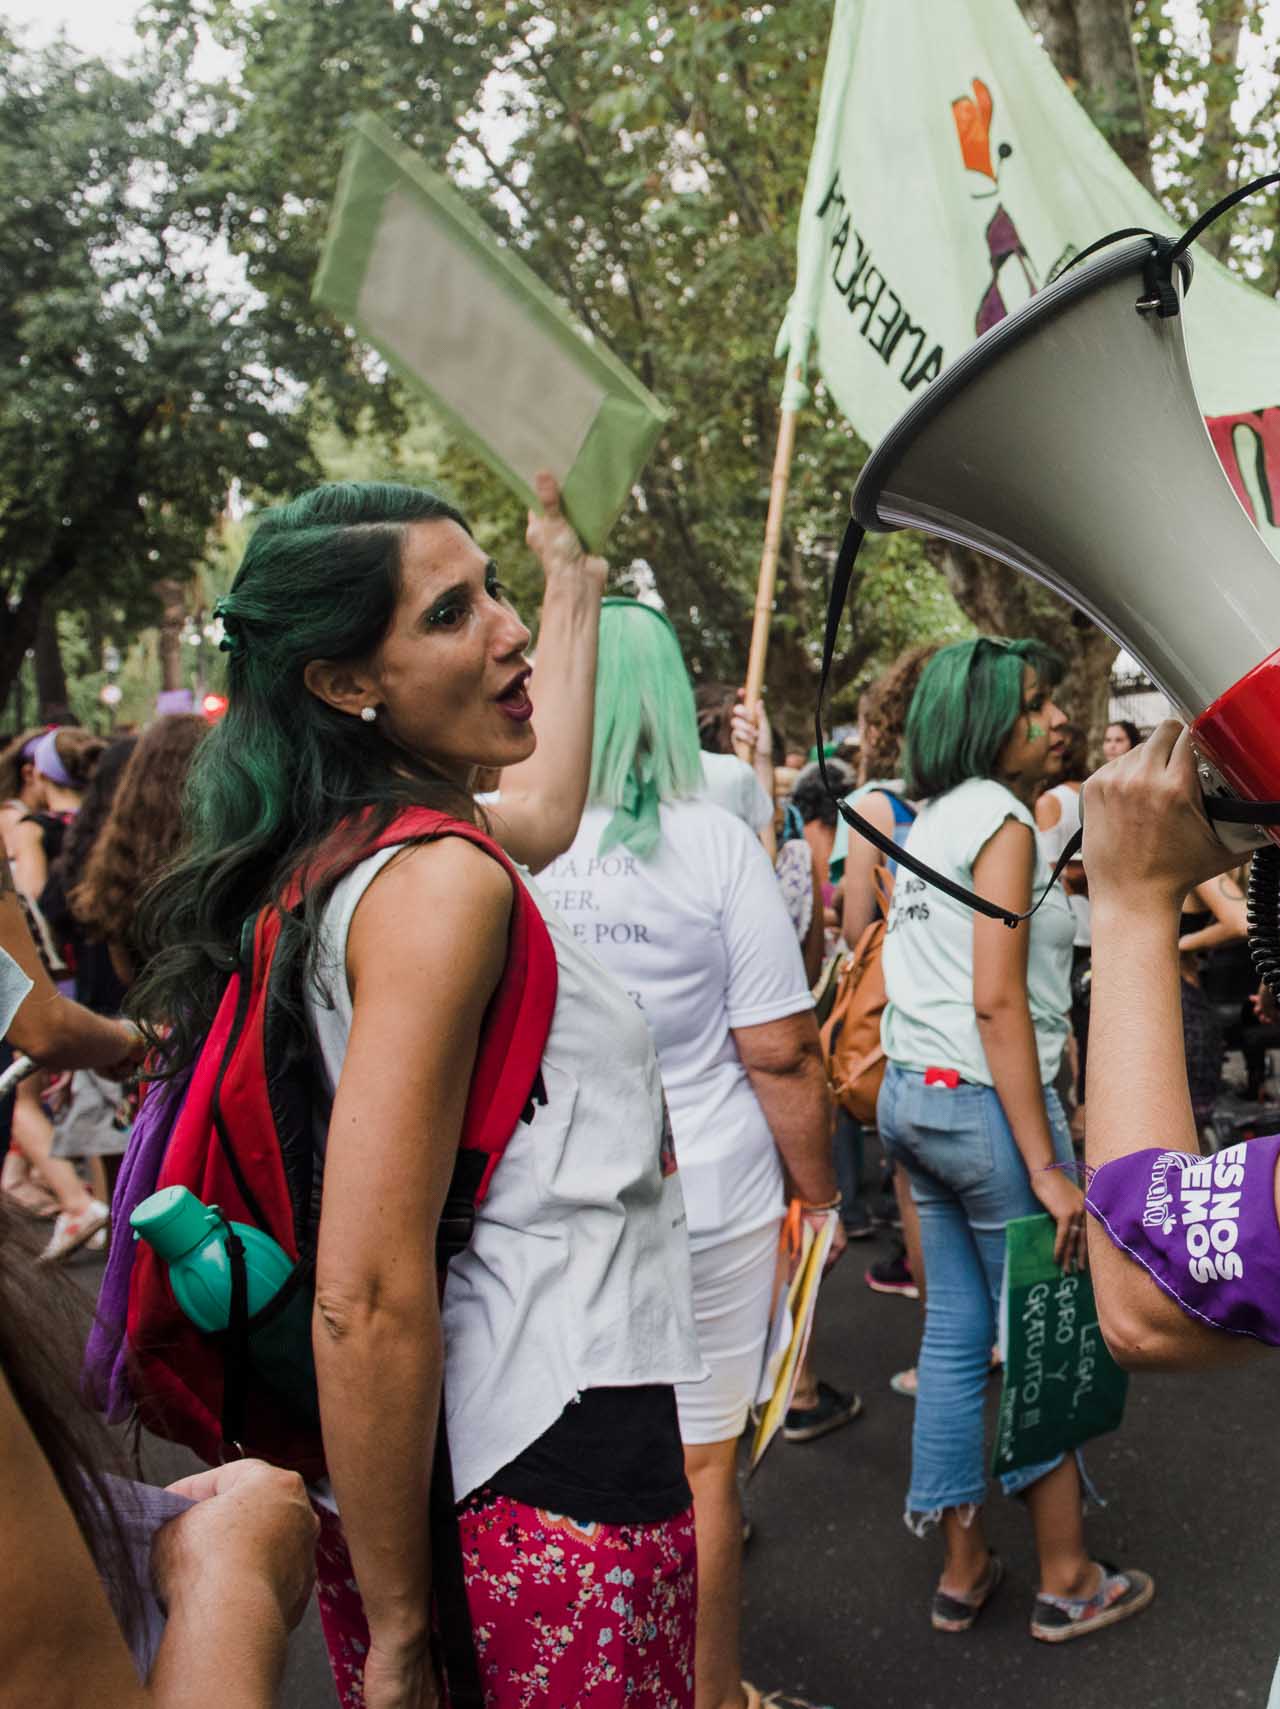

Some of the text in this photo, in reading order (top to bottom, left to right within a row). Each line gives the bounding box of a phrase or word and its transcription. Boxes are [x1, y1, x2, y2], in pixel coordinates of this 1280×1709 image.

[587, 856, 640, 877] POR
[595, 922, 652, 944] POR
[1180, 1158, 1219, 1284] EMOS
[1209, 1141, 1248, 1281] ES NOS
[1045, 1275, 1079, 1382] GURO Y
